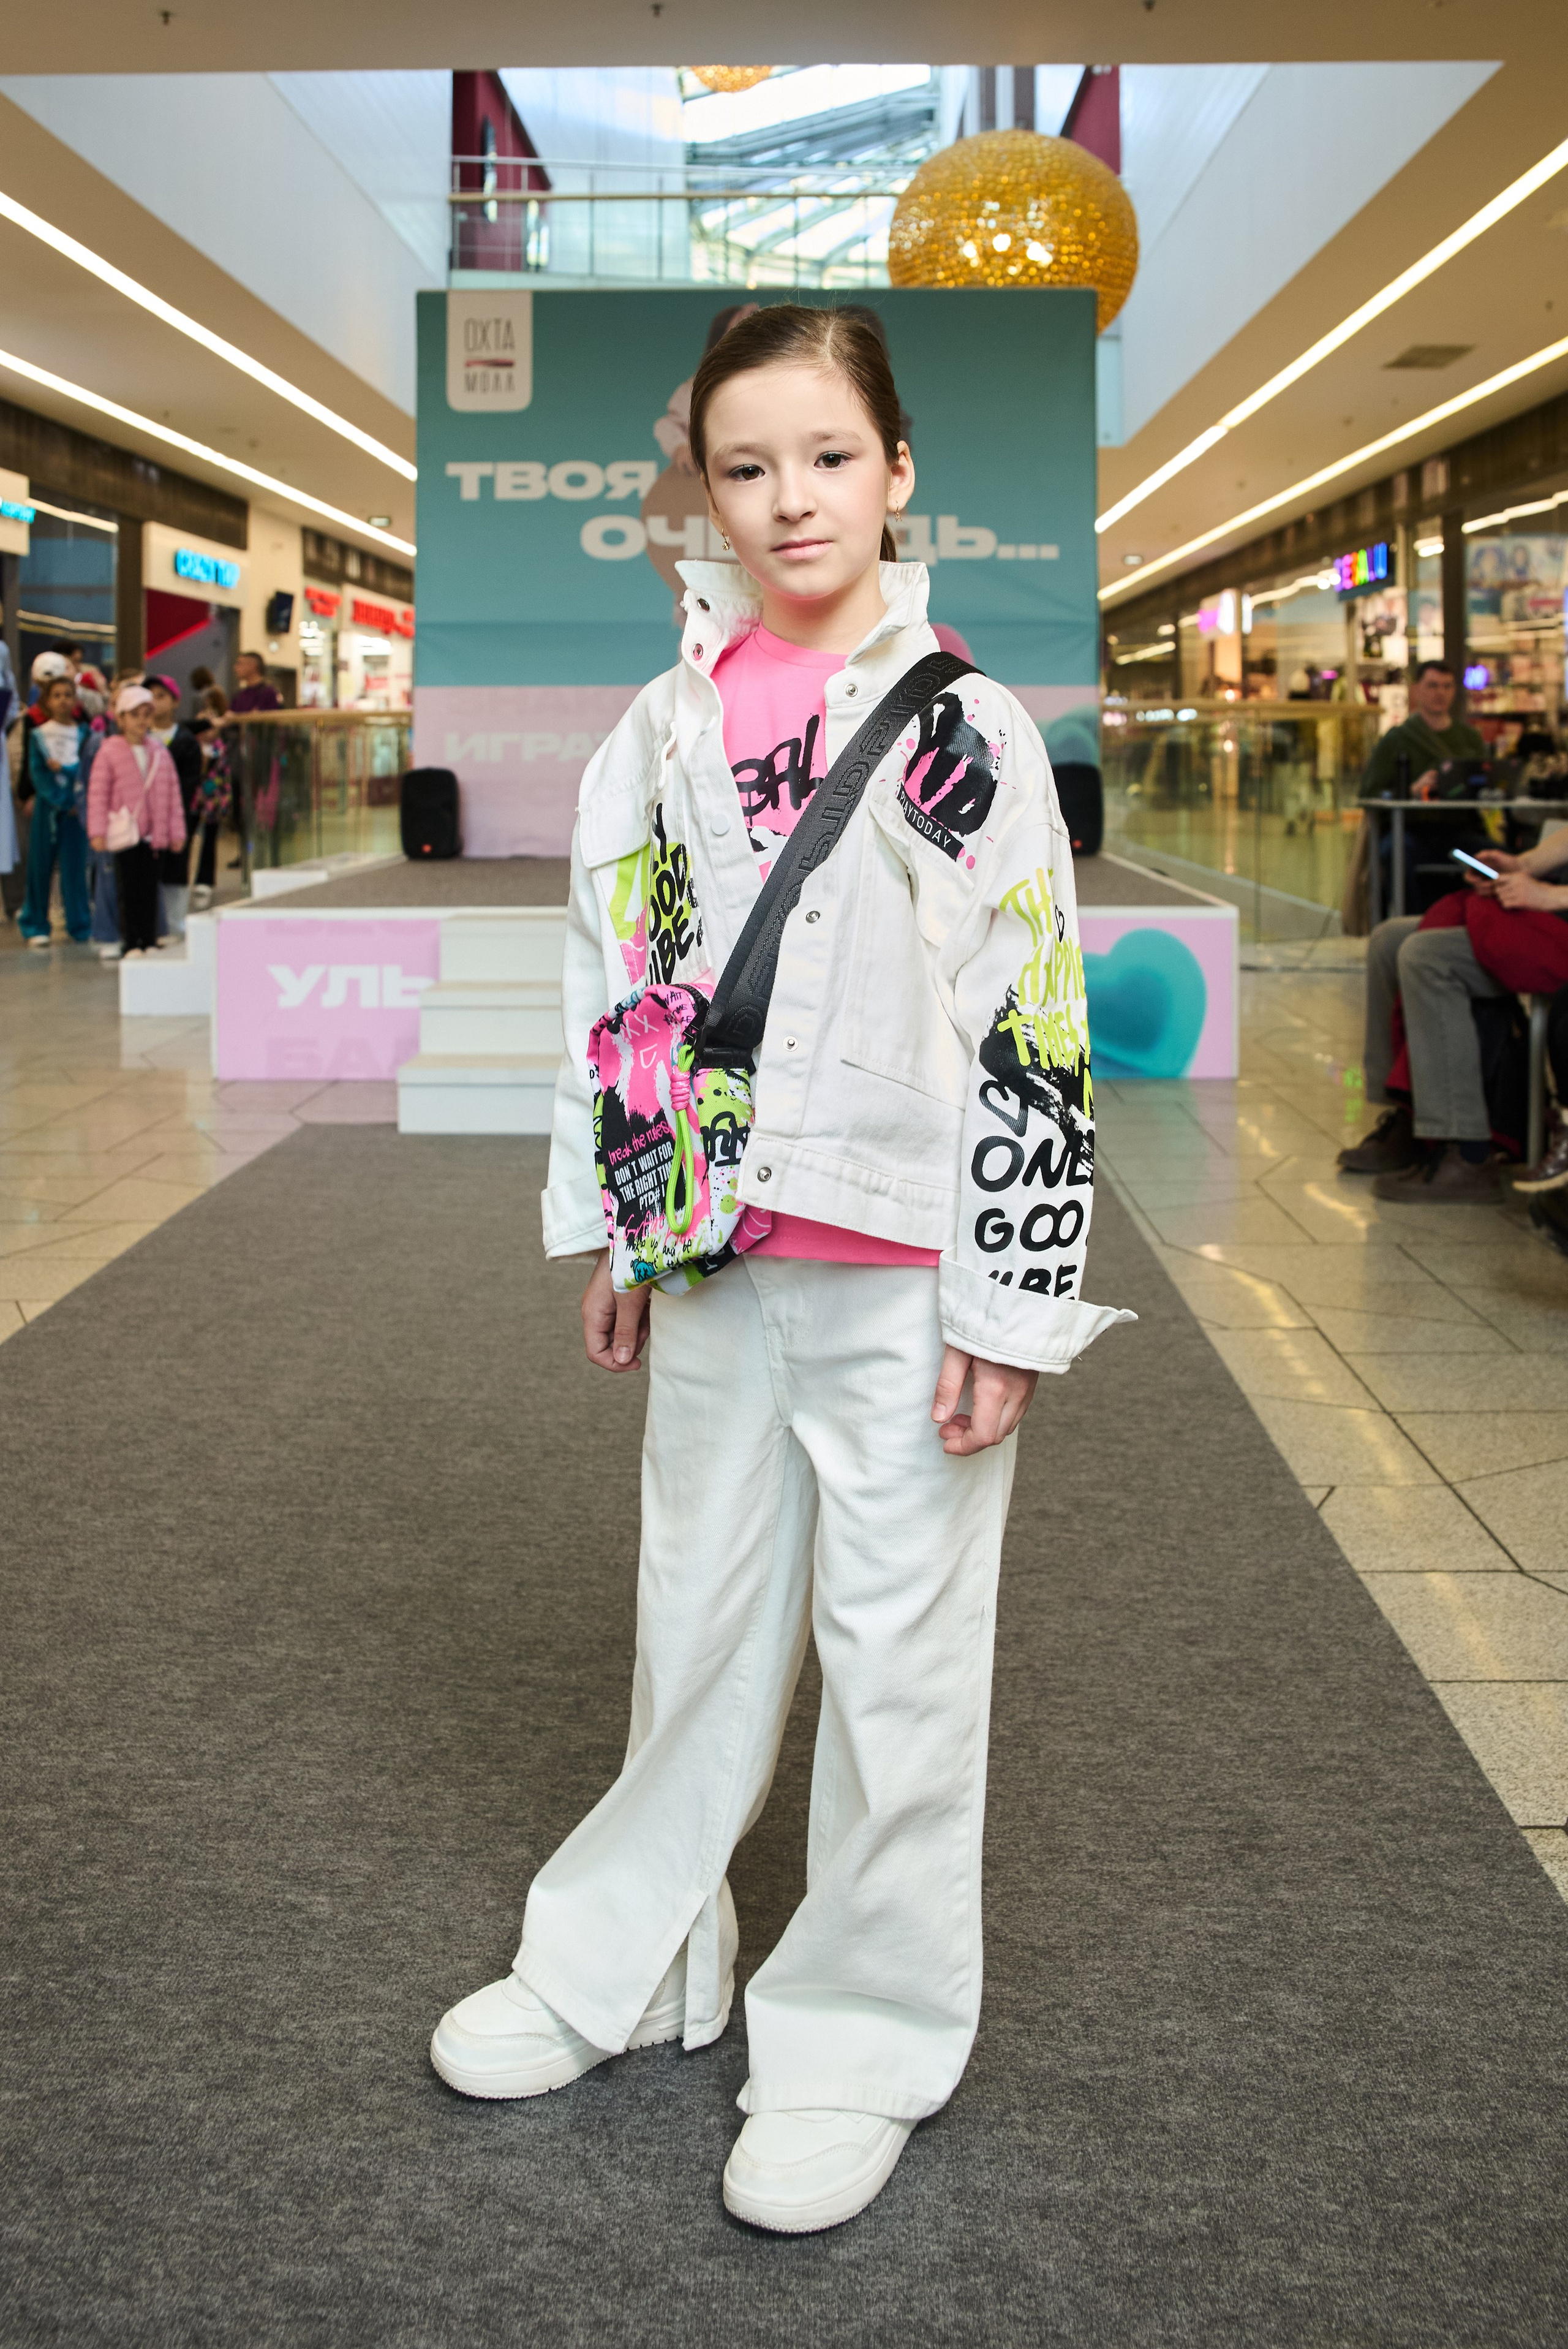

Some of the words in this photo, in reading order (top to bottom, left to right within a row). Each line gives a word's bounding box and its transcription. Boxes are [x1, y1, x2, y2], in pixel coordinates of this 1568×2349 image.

[464, 318, 515, 352] ОХТА
[445, 460, 658, 501] ТВОЯ
[445, 732, 611, 763] ИГРА
[999, 868, 1054, 947] TH
[631, 1133, 647, 1152] the
[638, 1148, 659, 1173] WAIT
[657, 1141, 674, 1162] FOR
[619, 1182, 636, 1203] THE
[634, 1169, 658, 1196] RIGHT
